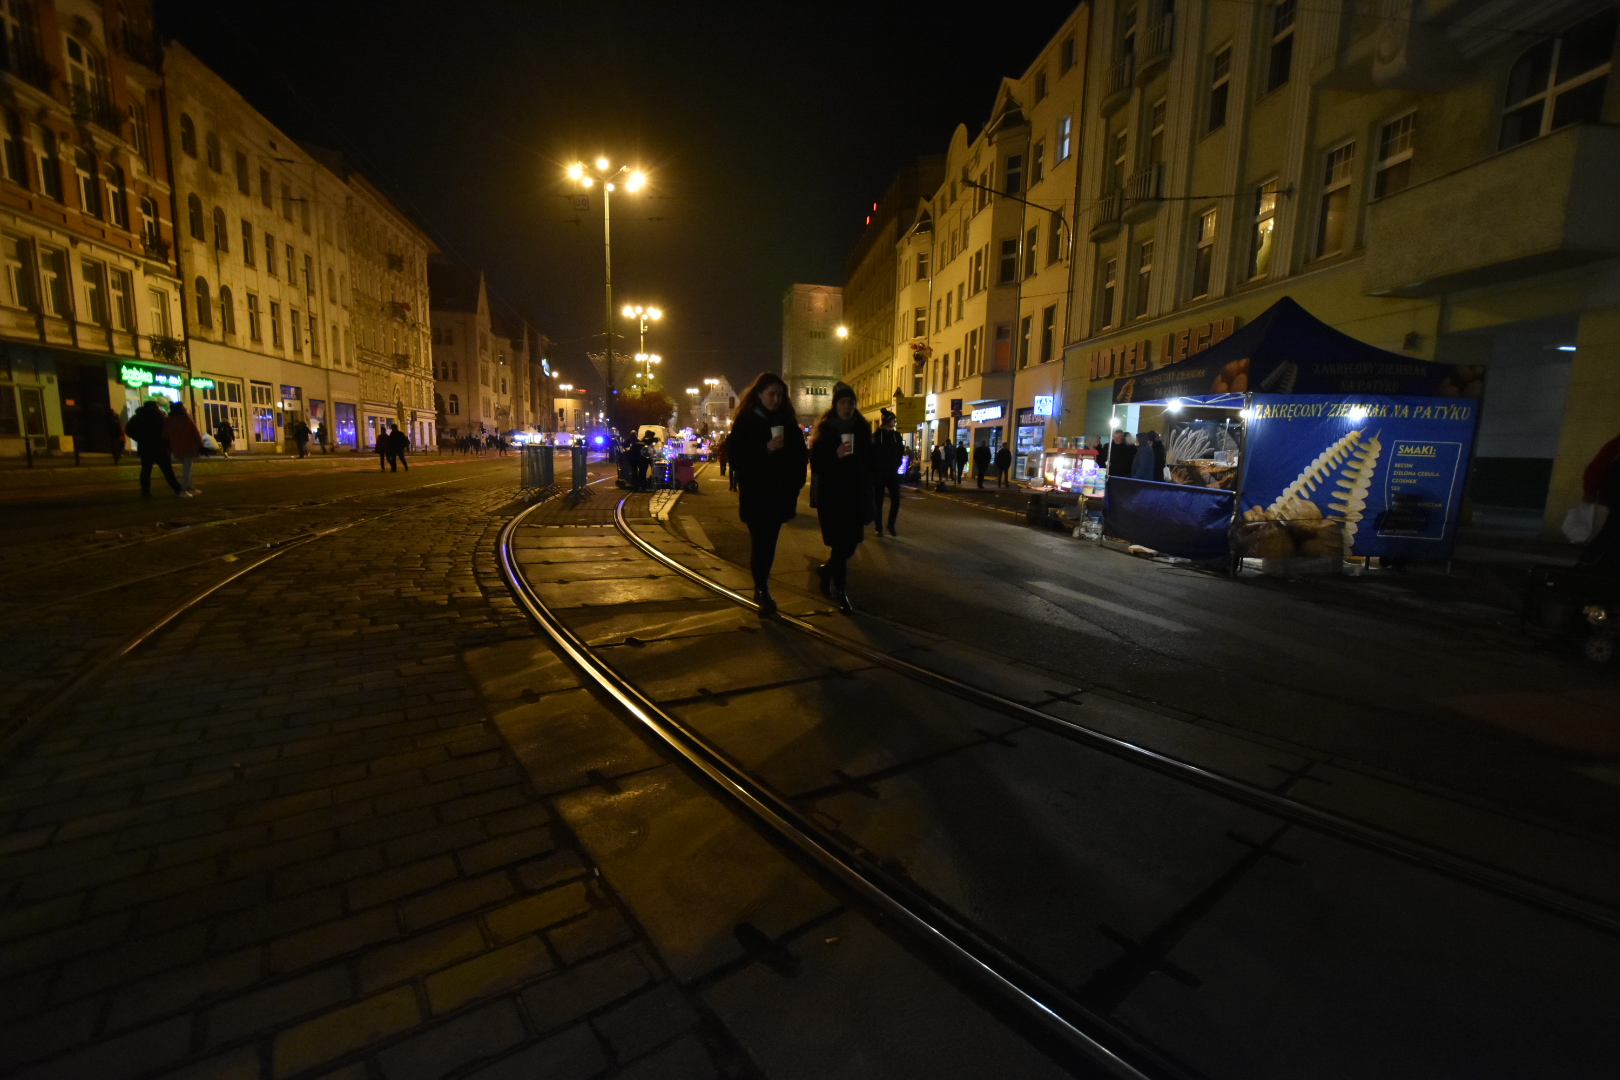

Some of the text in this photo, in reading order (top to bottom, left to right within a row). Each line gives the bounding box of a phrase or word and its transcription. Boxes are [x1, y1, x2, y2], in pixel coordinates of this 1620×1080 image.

[1088, 316, 1235, 381] HOTEL LECH
[1313, 362, 1427, 377] ZAKRĘCONY ZIEMNIAK
[1340, 379, 1400, 393] NA PATYKU
[1255, 402, 1472, 421] ZAKRĘCONY ZIEMNIAK NA PATYKU
[1398, 445, 1437, 455] SMAKI:
